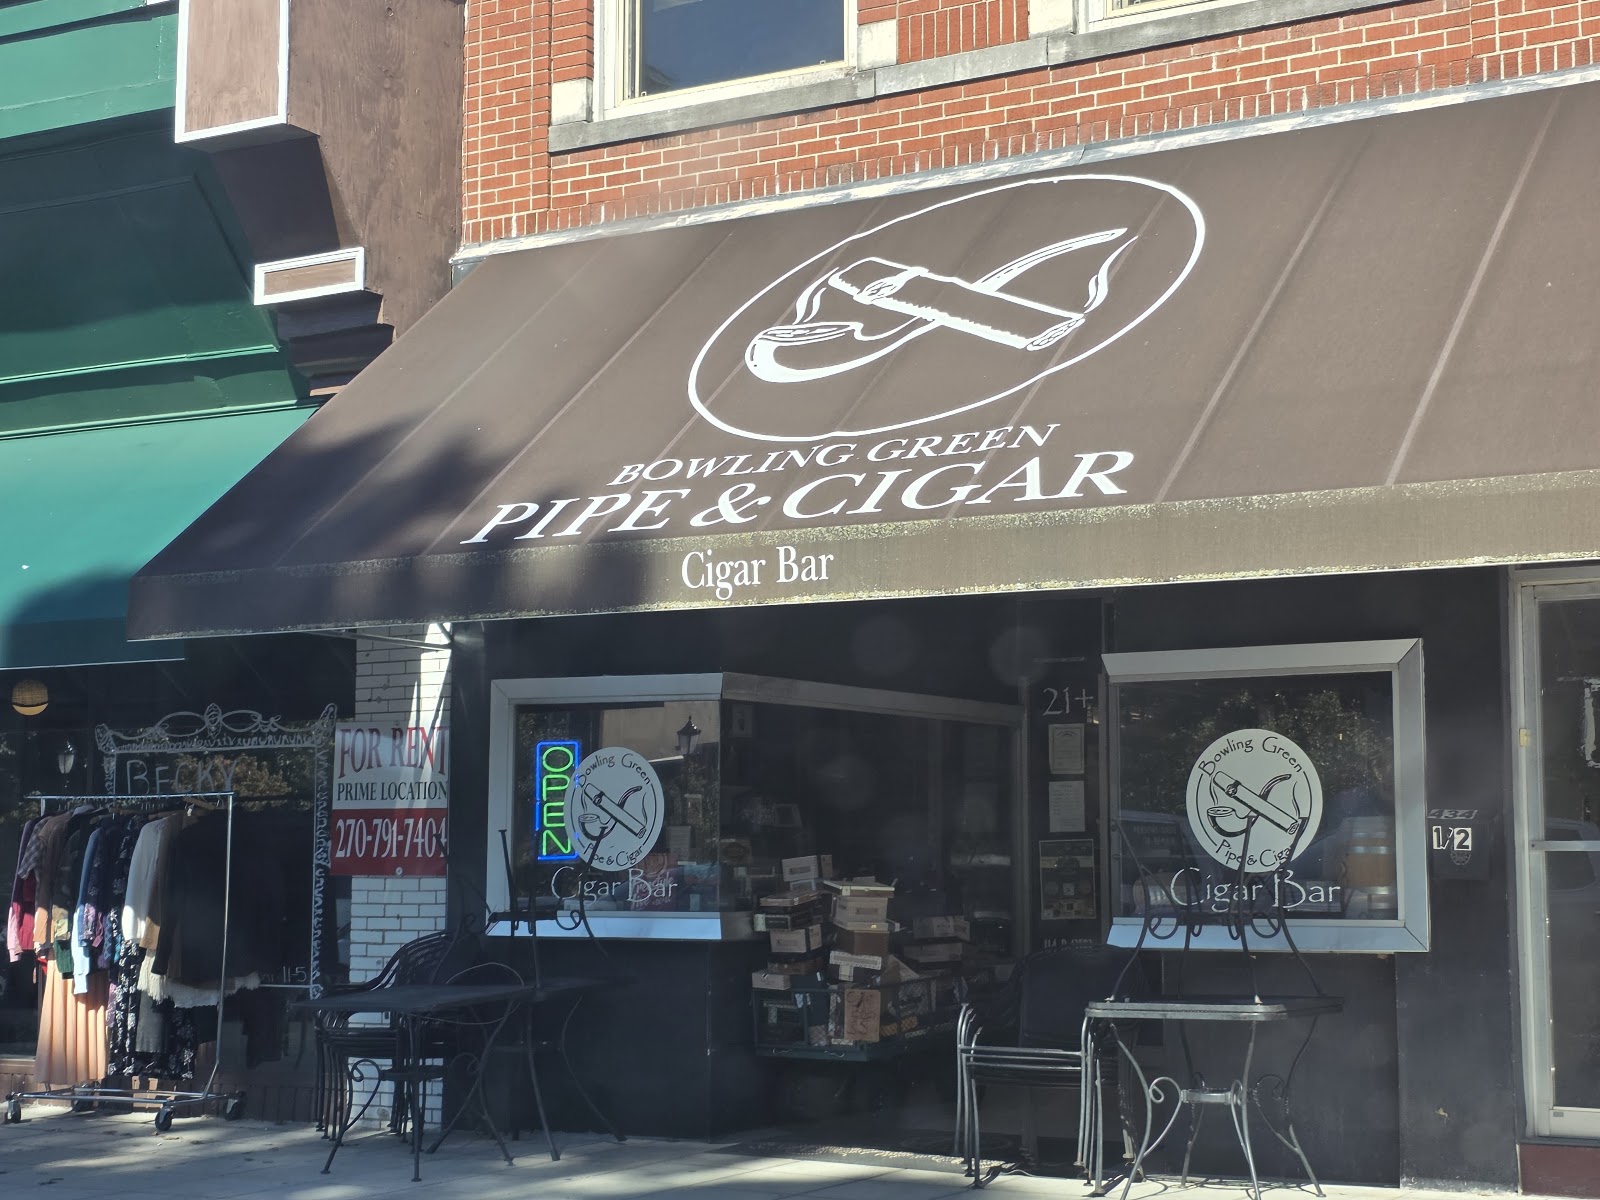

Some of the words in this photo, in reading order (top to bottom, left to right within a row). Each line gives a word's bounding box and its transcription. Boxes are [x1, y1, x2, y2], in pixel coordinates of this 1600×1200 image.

[606, 443, 857, 486] BOWLING
[867, 423, 1060, 463] GREEN
[460, 487, 691, 545] PIPE
[689, 482, 772, 527] &
[782, 451, 1135, 519] CIGAR
[681, 549, 765, 600] Cigar
[776, 545, 834, 584] Bar
[1042, 687, 1094, 716] 21+
[338, 726, 382, 779] FOR
[390, 726, 449, 775] RENT
[621, 753, 651, 785] Green
[1198, 738, 1253, 777] Bowling
[1262, 736, 1303, 773] Green
[337, 781, 376, 801] PRIME
[380, 780, 448, 801] LOCATION
[542, 746, 574, 857] OPEN
[1428, 809, 1476, 819] 434
[606, 854, 615, 865] &
[616, 846, 643, 867] Cigar
[1247, 854, 1257, 866] &
[1260, 847, 1293, 867] Ciga
[551, 866, 621, 905] Cigar
[627, 868, 678, 901] Bar
[1170, 867, 1263, 913] Cigar
[1273, 869, 1341, 912] Bar
